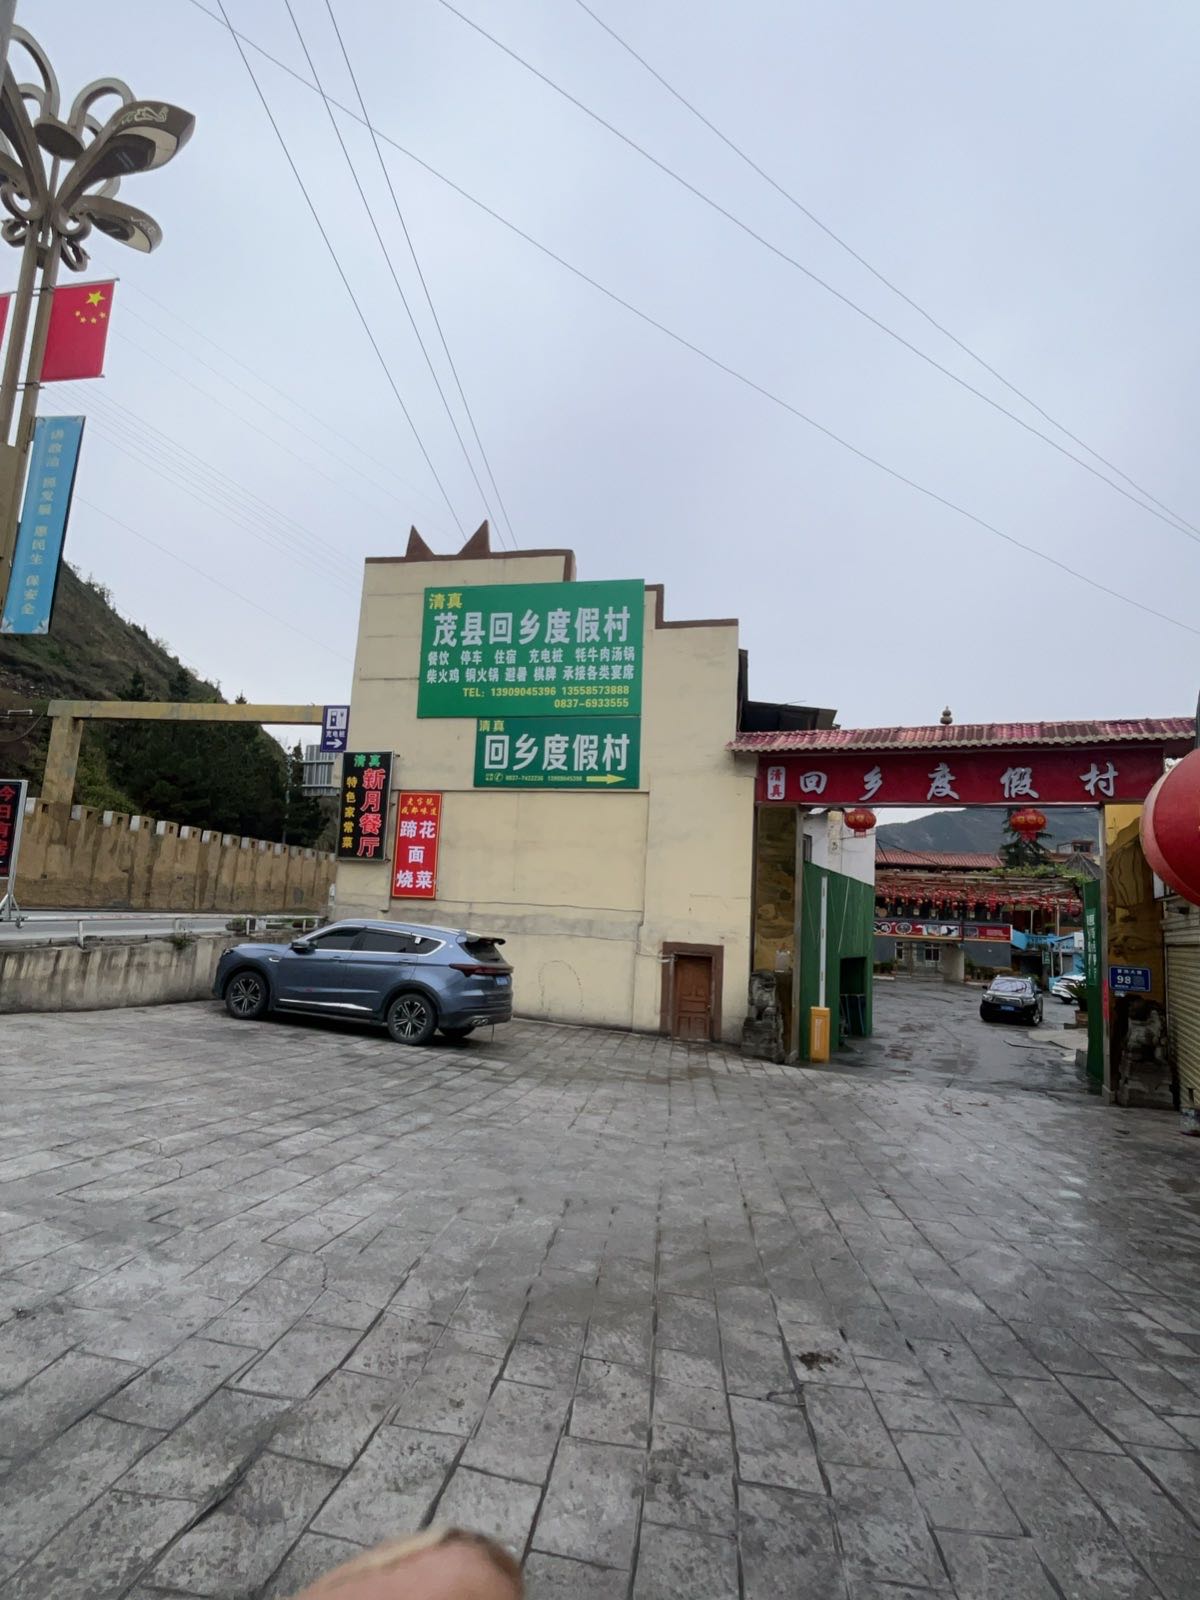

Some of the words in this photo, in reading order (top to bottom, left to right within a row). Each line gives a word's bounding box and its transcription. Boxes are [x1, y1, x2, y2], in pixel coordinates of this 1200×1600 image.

[21, 575, 39, 615] 保安全
[429, 593, 463, 610] 清真
[432, 606, 630, 647] 茂县回乡度假村
[428, 650, 450, 666] 餐饮
[461, 650, 482, 665] 停车
[495, 649, 517, 664] 住宿
[529, 648, 563, 663] 充电桩
[575, 646, 635, 662] 牦牛肉汤锅
[427, 668, 460, 684] 柴火鸡
[505, 666, 527, 682] 避暑
[533, 665, 557, 681] 棋牌
[562, 664, 634, 681] 承接各类宴席
[491, 686, 556, 697] 13909045396
[562, 685, 630, 695] 13558573888
[554, 698, 630, 708] 0837-6933555
[479, 720, 505, 732] 清真
[354, 754, 381, 768] 清真
[484, 733, 630, 771] 回乡度假村
[770, 768, 783, 798] 清真
[800, 761, 1118, 801] 回乡度假村
[341, 776, 358, 849] 特色家常菜
[357, 768, 386, 858] 新月餐厅
[399, 820, 436, 839] 蹄花
[408, 846, 425, 864] 面
[396, 870, 434, 889] 烧菜
[1116, 975, 1132, 985] 98
